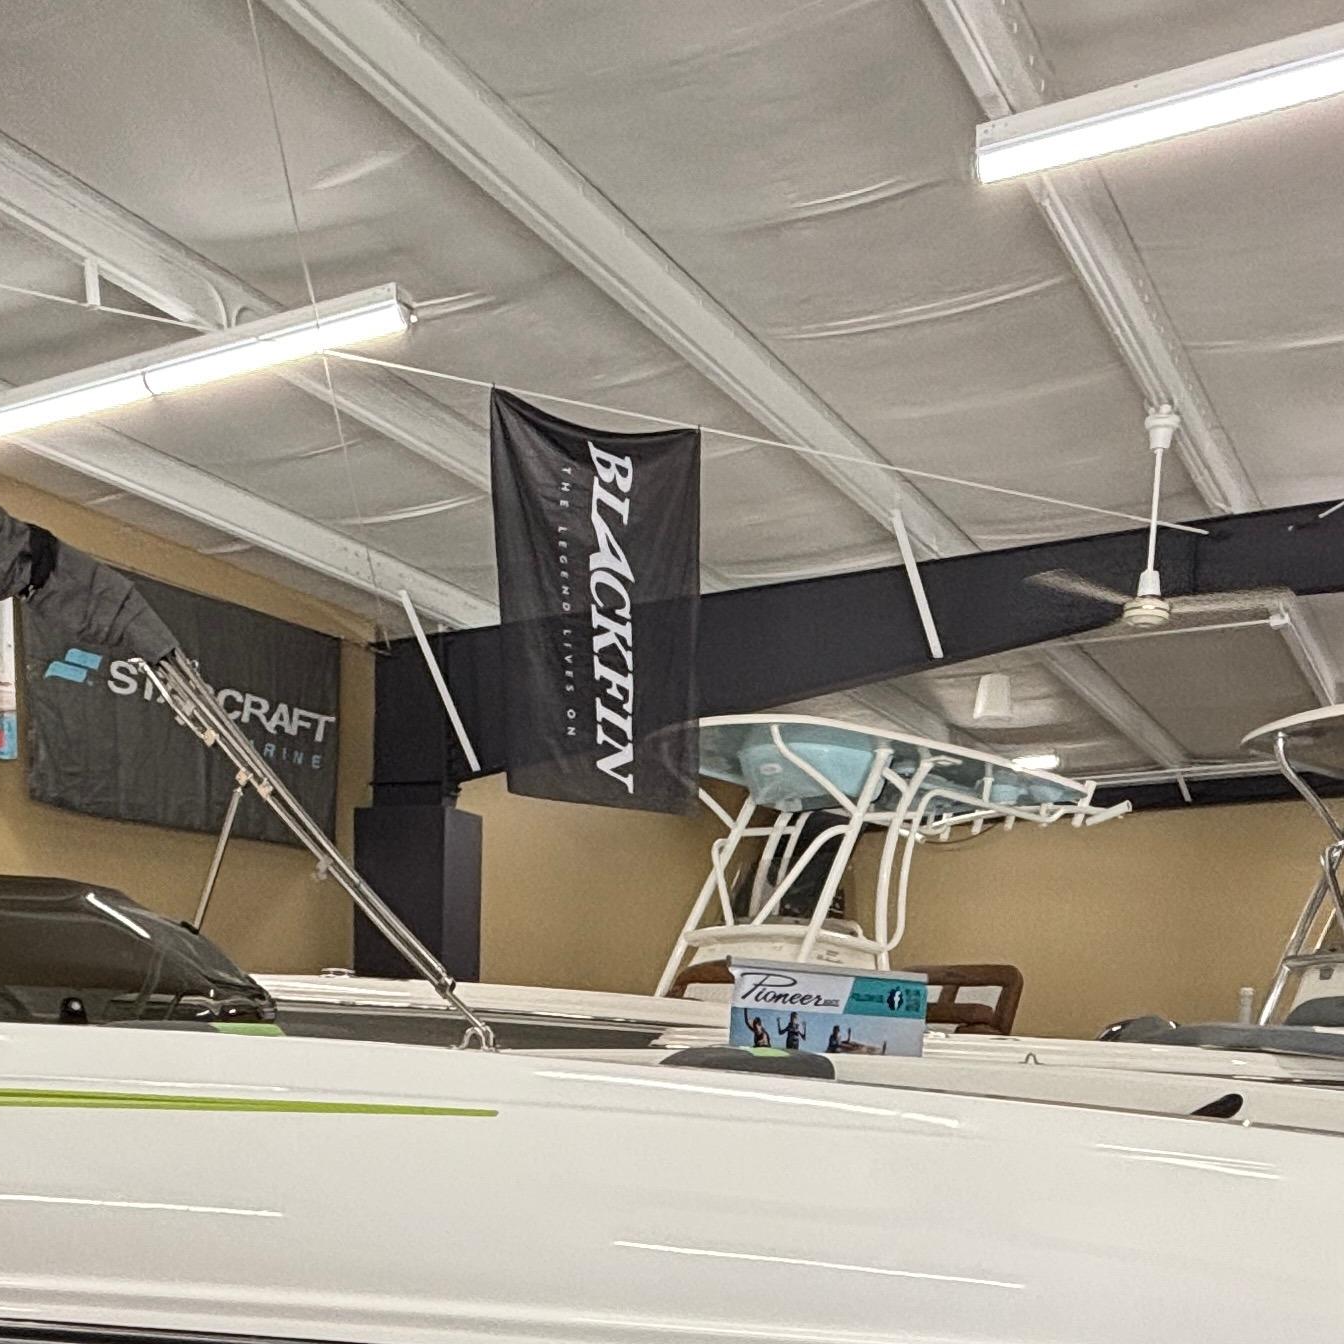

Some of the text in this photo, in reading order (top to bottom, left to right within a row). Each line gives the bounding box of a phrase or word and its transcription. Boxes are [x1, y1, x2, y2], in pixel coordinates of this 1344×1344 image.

[558, 467, 576, 737] THE LEGEND LIVES ON
[587, 441, 635, 794] BLACKFIN
[107, 658, 336, 743] STCRAFT
[740, 972, 826, 1008] Pioneer
